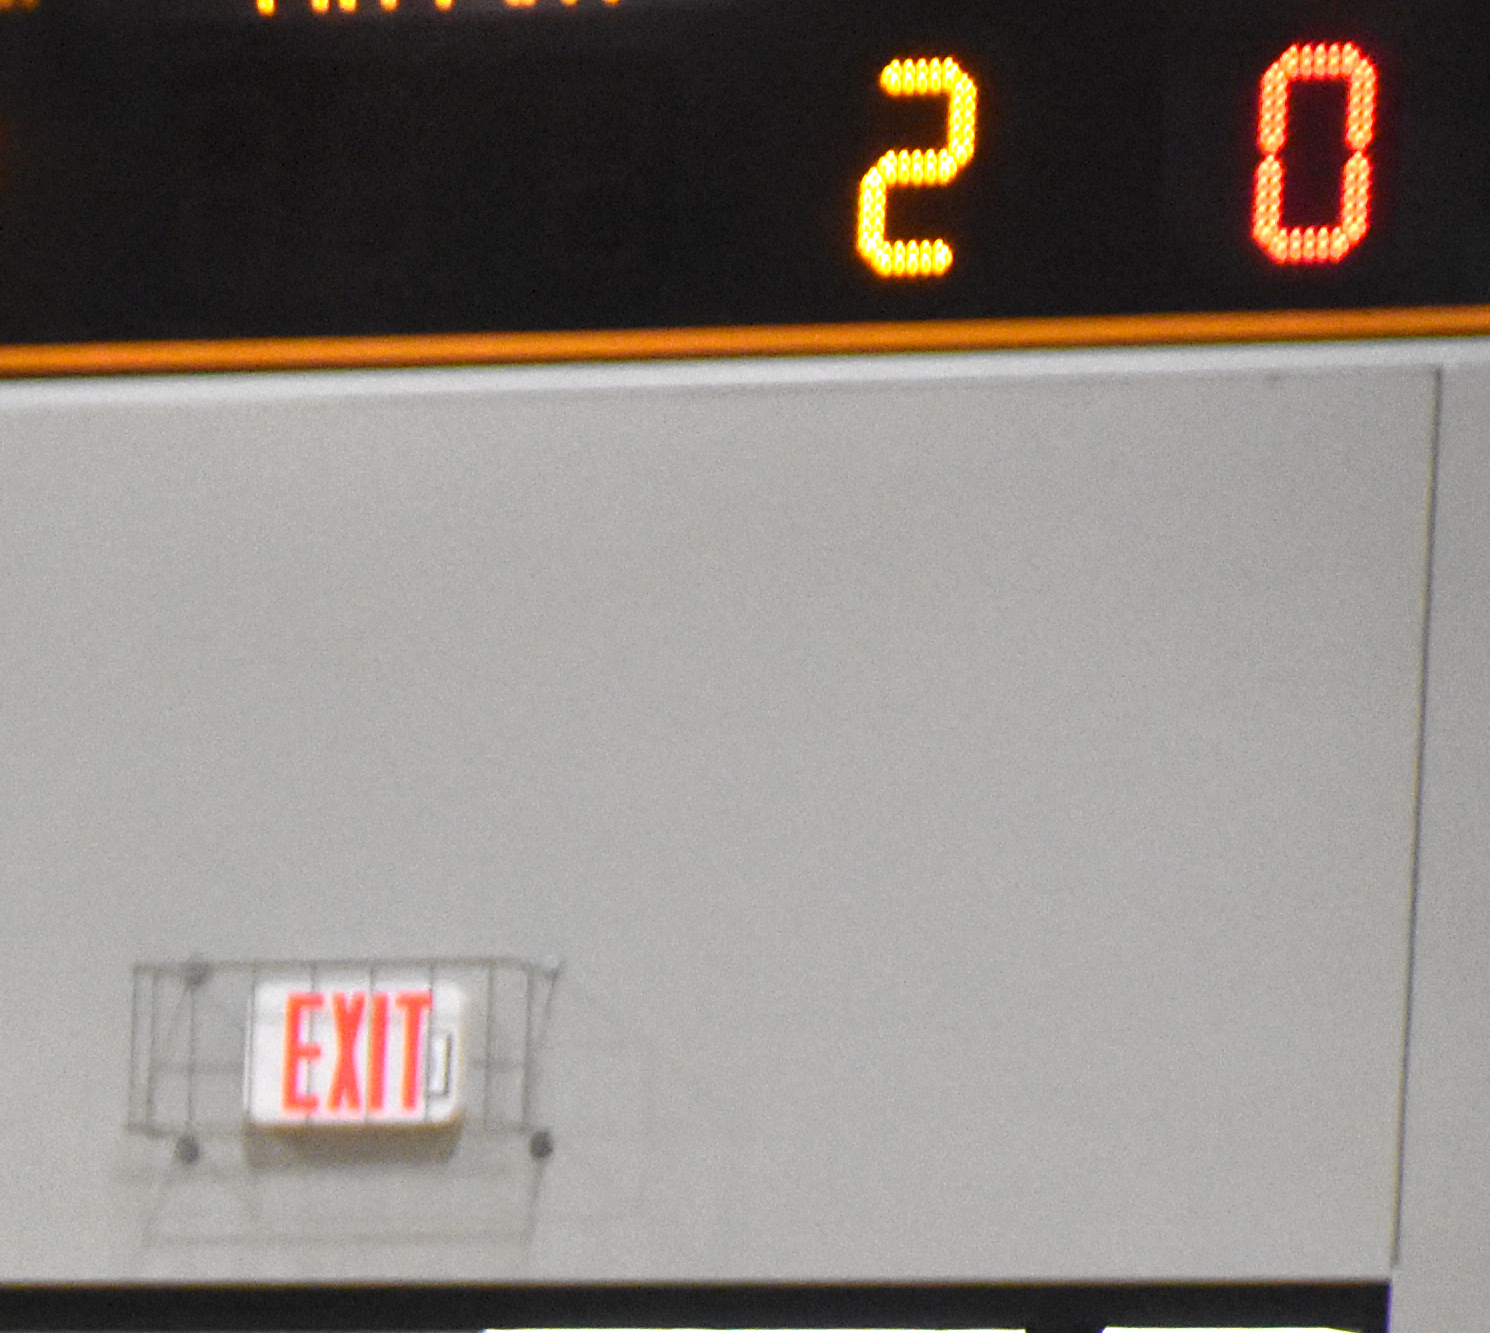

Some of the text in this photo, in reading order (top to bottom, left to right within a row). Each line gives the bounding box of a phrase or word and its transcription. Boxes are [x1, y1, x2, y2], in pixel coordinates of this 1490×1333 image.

[857, 56, 977, 278] 2
[1251, 41, 1377, 264] 0
[281, 989, 433, 1115] EXIT
